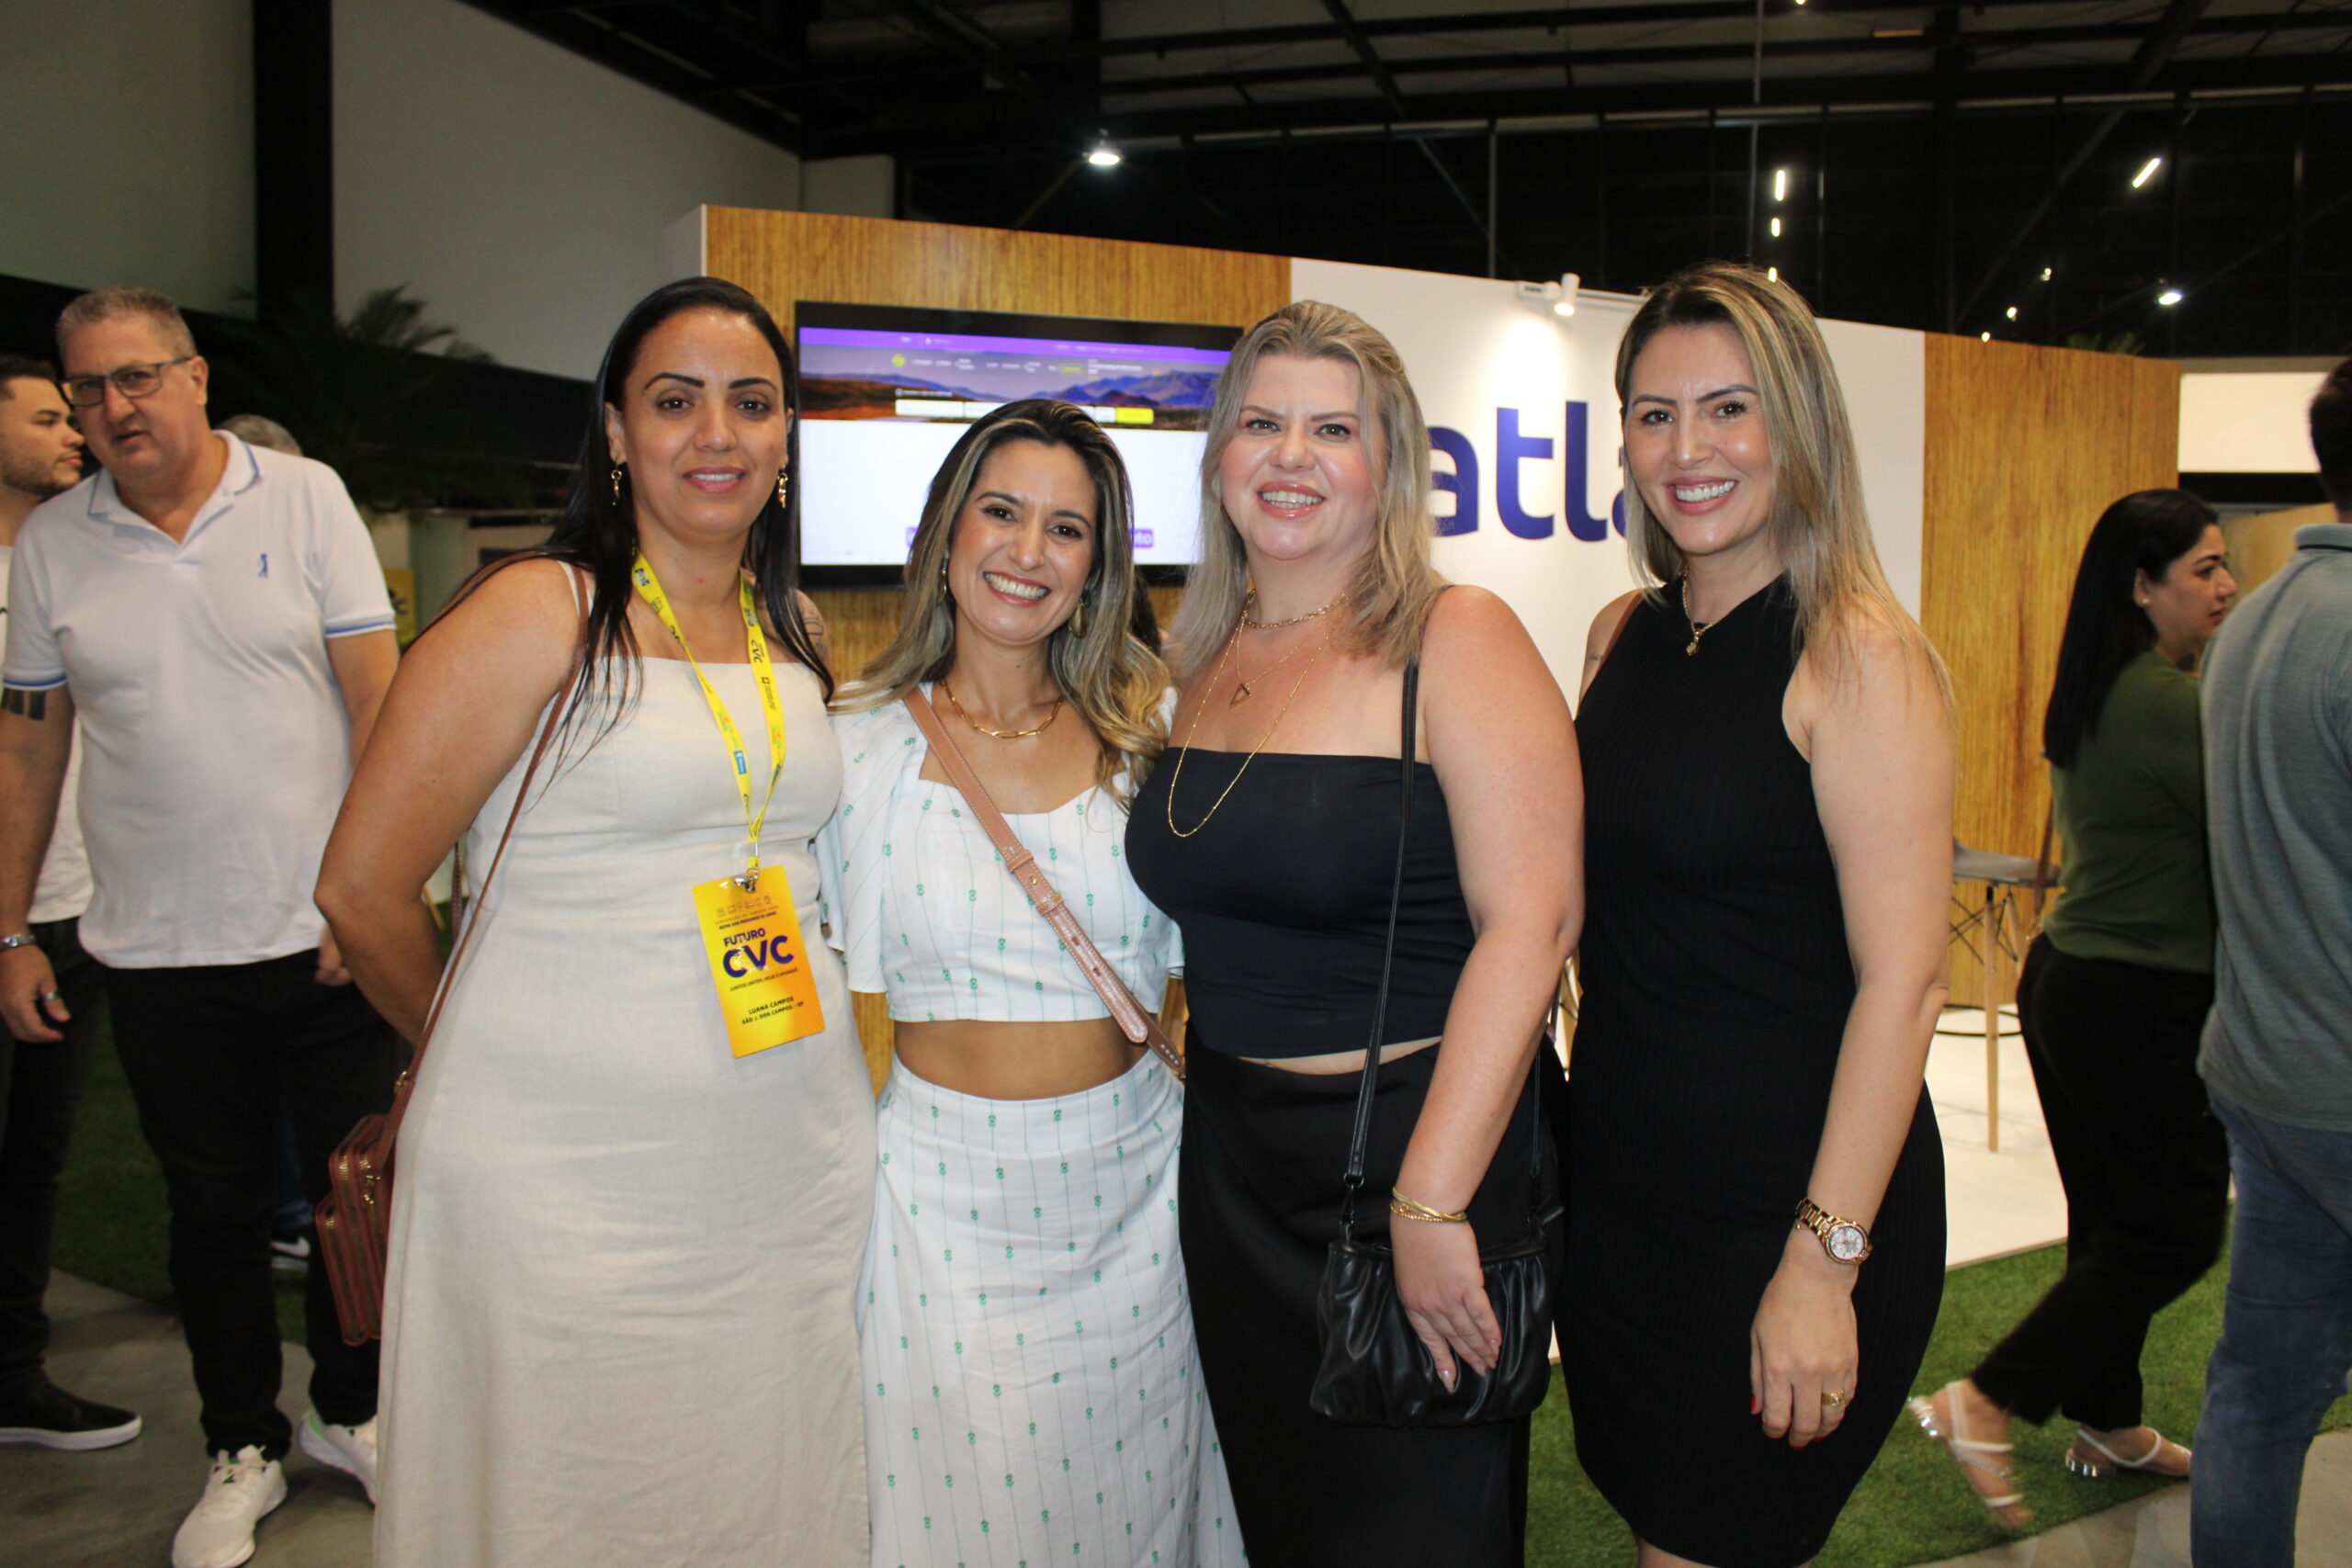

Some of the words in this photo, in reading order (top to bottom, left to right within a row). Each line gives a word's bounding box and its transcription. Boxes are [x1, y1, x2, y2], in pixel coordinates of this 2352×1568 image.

[724, 928, 765, 947] FUTURO
[723, 935, 794, 978] CVC
[749, 1004, 768, 1014] LUANA
[770, 996, 794, 1008] CAMPOS
[771, 1004, 793, 1016] CAMPOS
